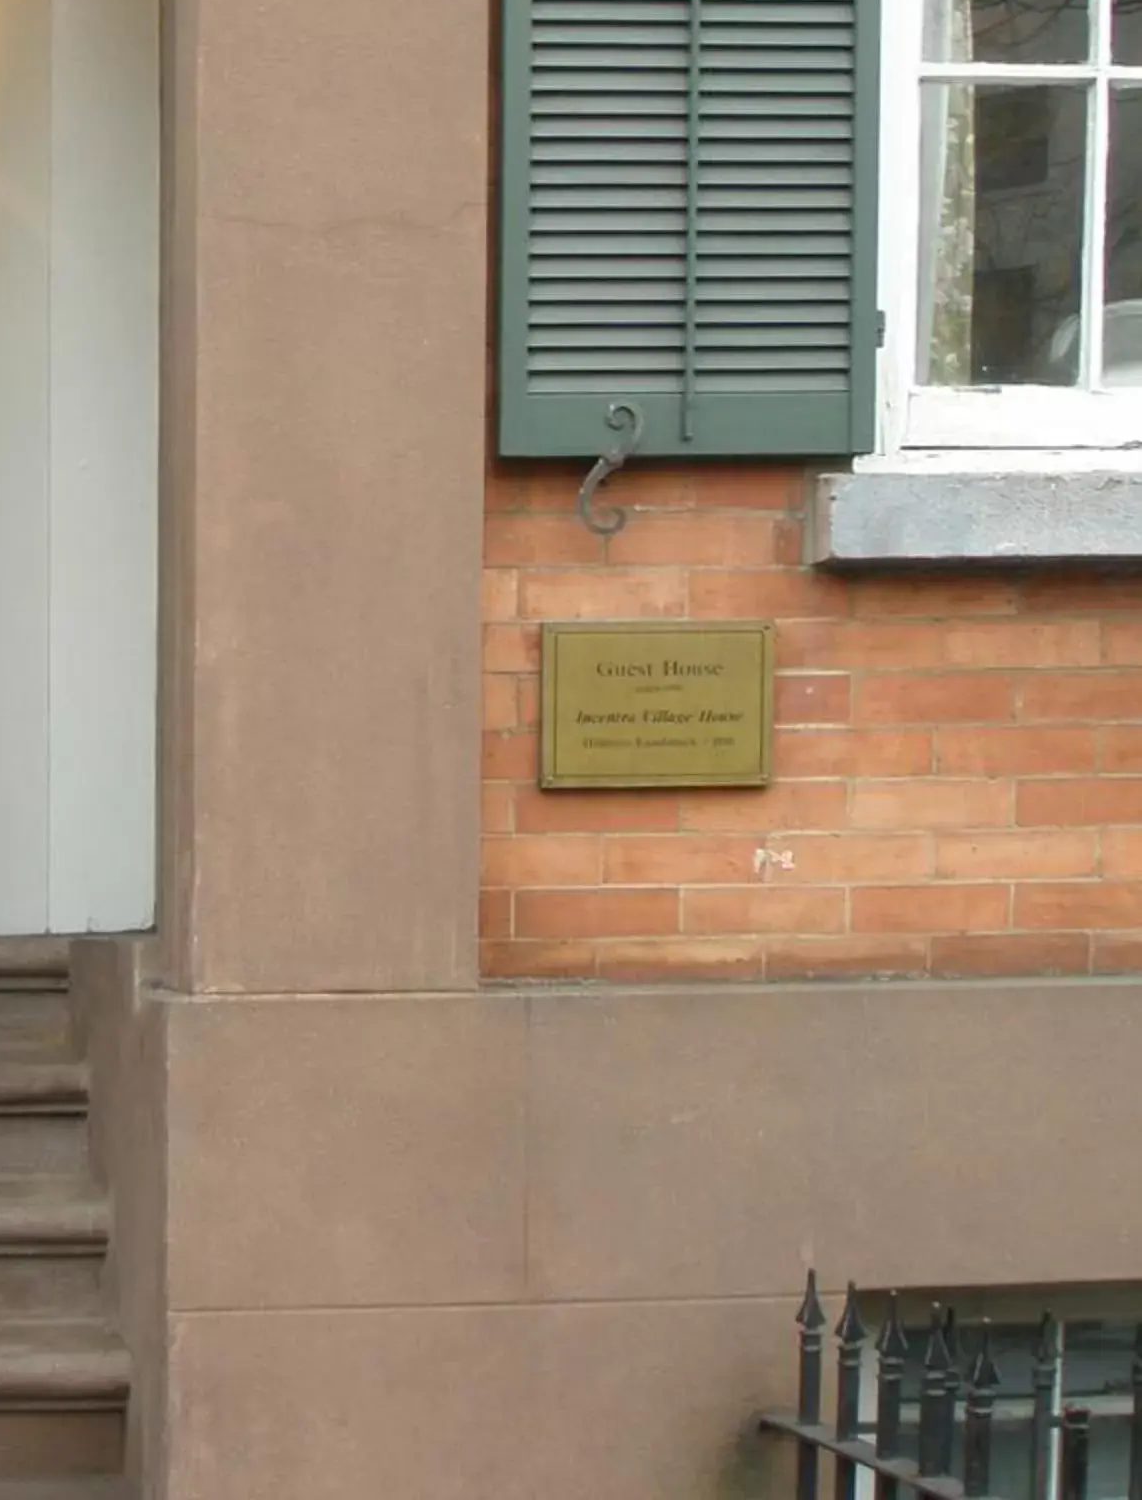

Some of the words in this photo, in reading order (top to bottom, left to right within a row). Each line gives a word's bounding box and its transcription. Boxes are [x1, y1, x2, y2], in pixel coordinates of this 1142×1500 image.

[596, 660, 653, 678] Guest
[663, 659, 725, 678] House
[642, 708, 693, 725] Village
